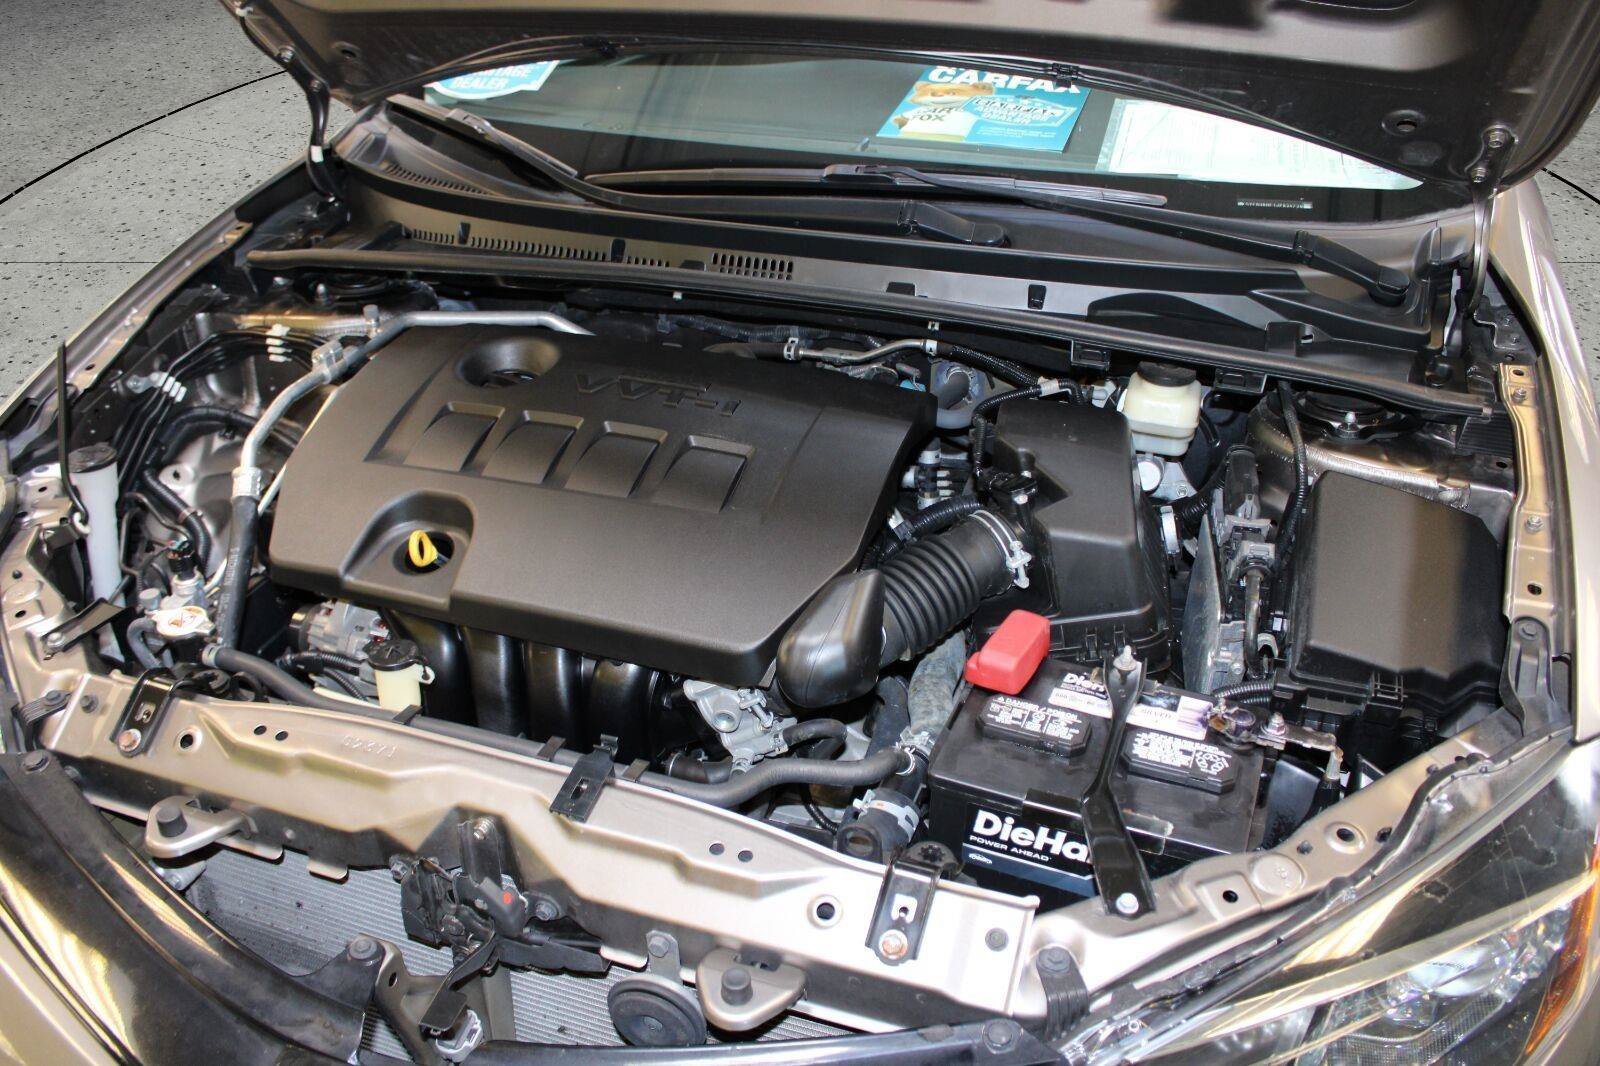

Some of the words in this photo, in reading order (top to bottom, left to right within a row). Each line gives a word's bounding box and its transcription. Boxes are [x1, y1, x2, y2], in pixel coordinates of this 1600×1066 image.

[448, 76, 509, 89] DEALER
[969, 835, 1008, 850] POWER
[1010, 847, 1050, 862] AHEAD
[972, 809, 1091, 863] DieHa
